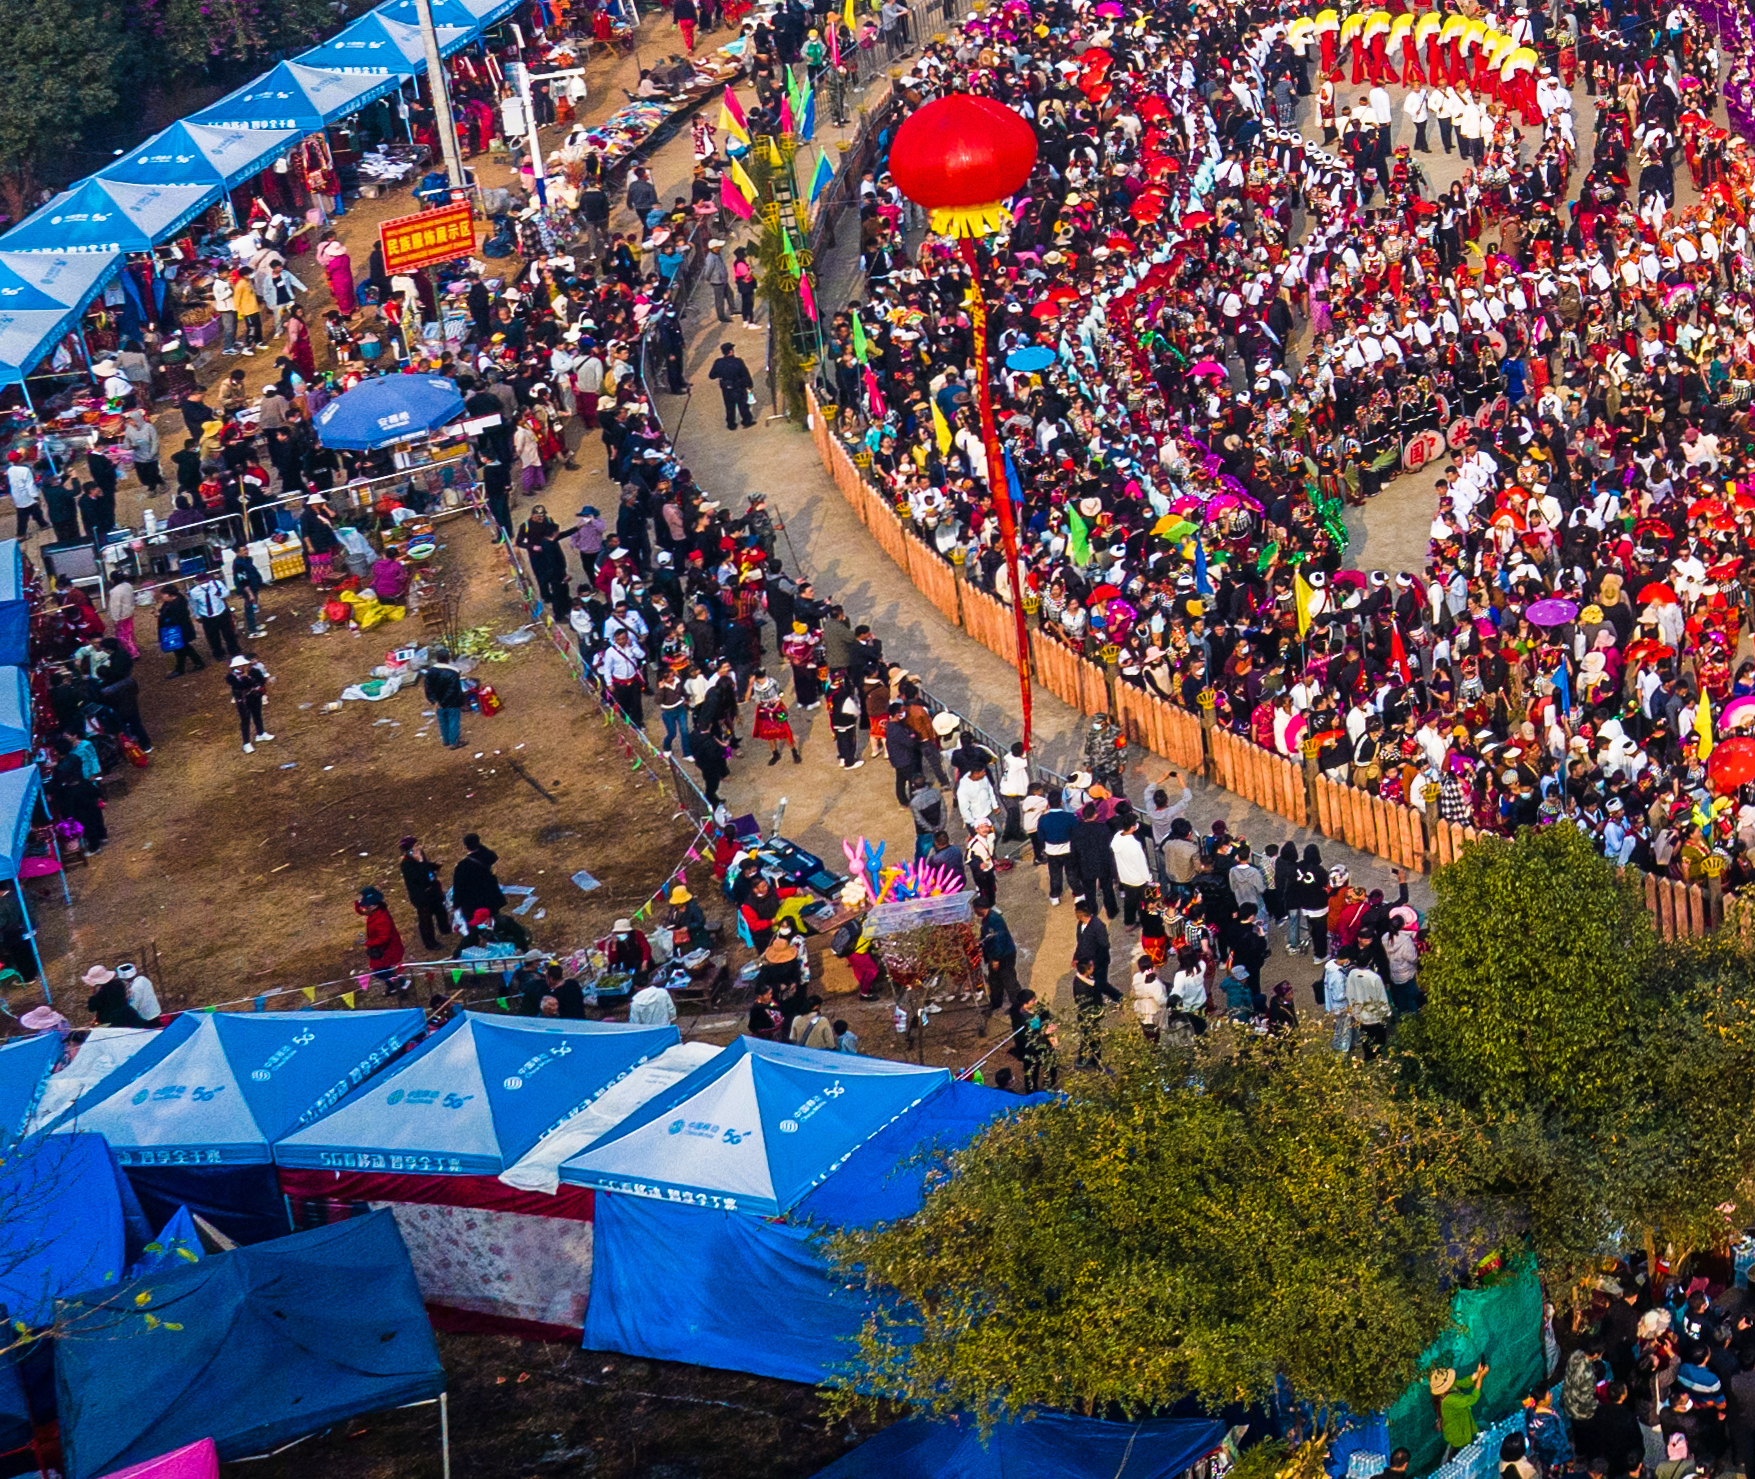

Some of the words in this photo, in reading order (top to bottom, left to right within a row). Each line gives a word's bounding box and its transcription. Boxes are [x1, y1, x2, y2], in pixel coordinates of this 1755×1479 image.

[386, 220, 472, 256] 民族服饰展示区
